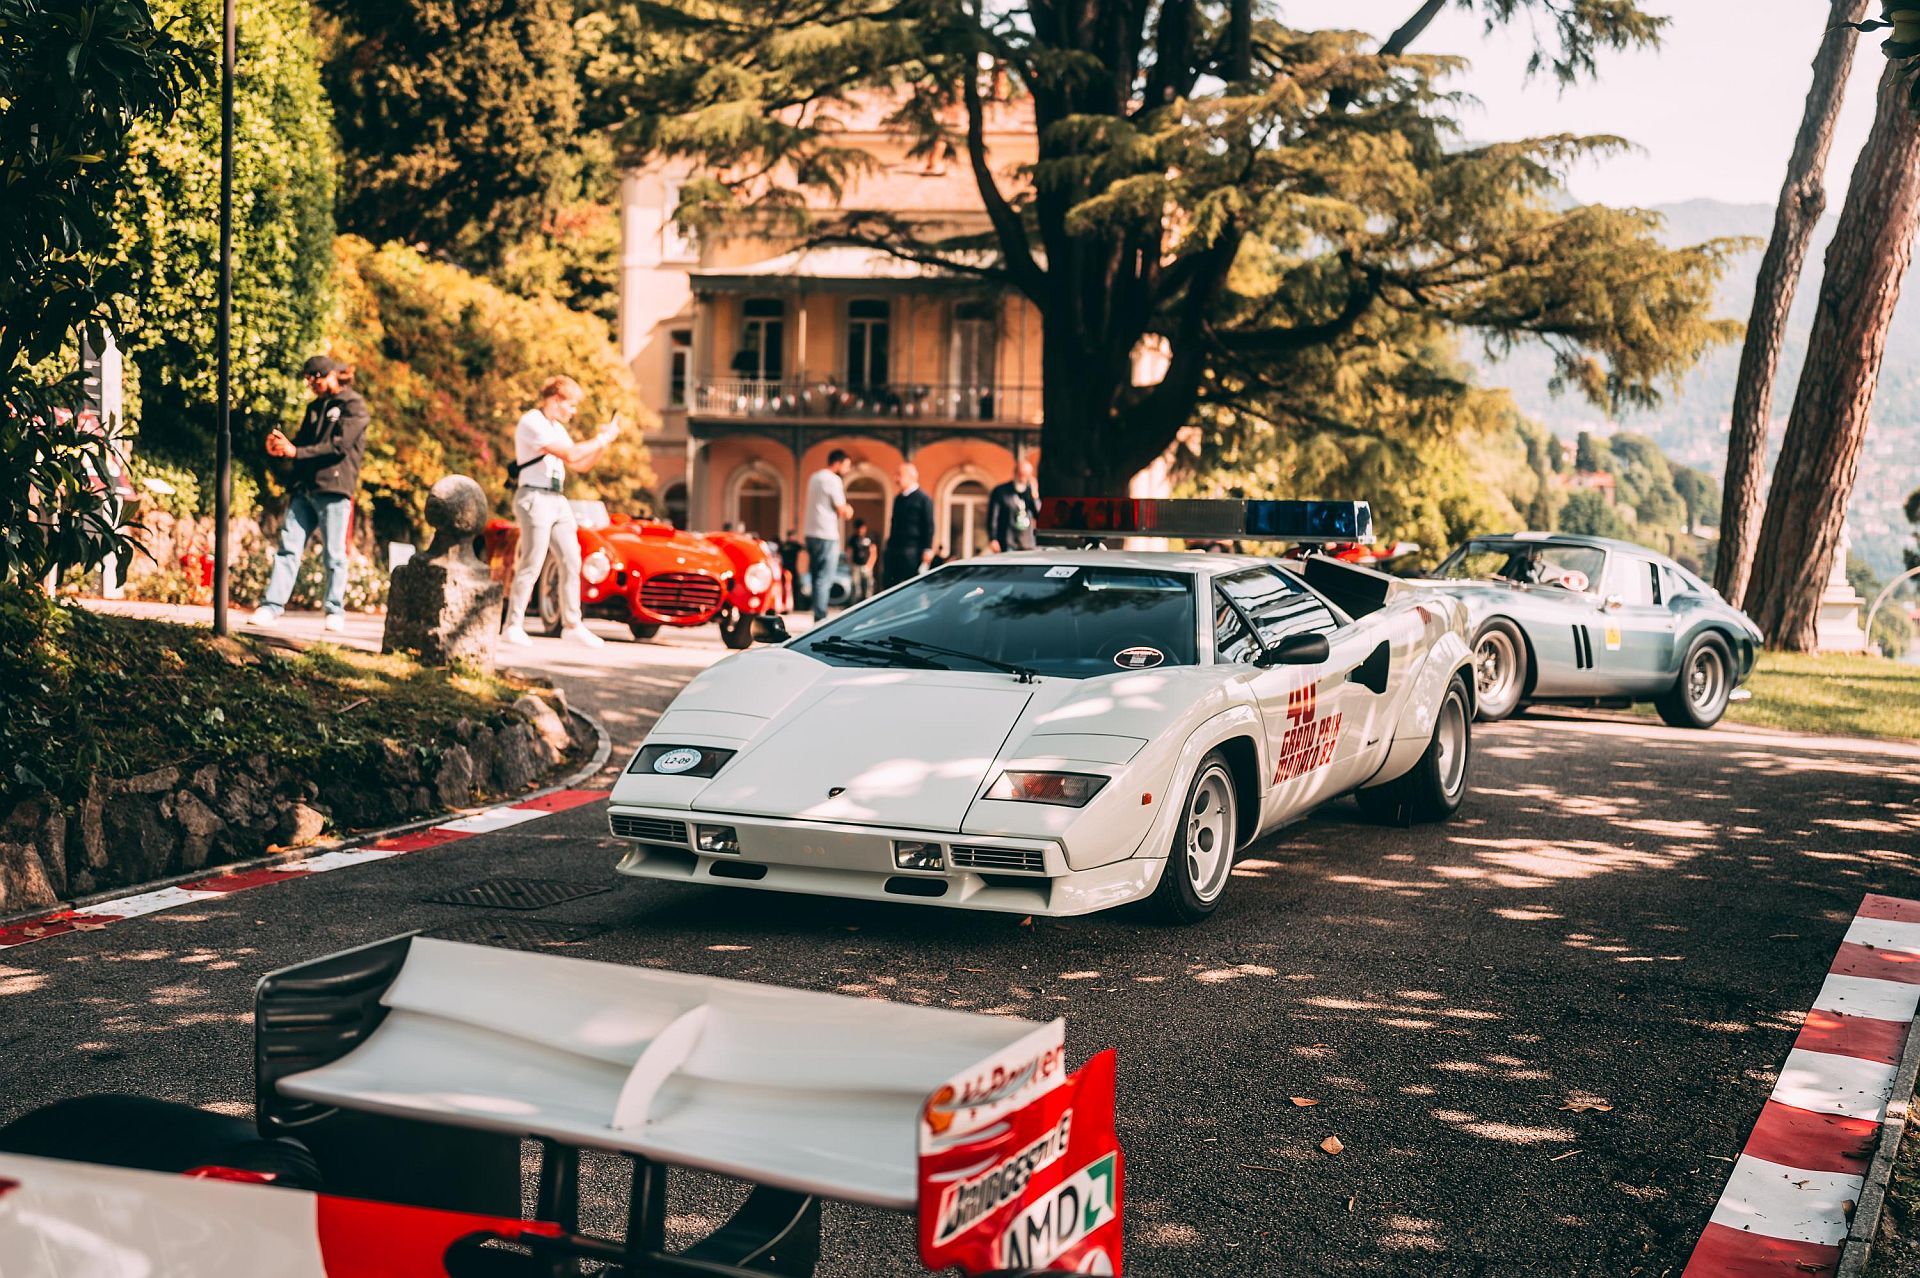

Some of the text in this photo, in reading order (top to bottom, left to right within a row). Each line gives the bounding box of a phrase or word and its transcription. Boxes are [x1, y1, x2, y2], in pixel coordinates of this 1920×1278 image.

[1280, 712, 1342, 758] GRAND PRIX
[1273, 739, 1336, 785] MONACO 82
[1004, 1184, 1080, 1270] AMD
